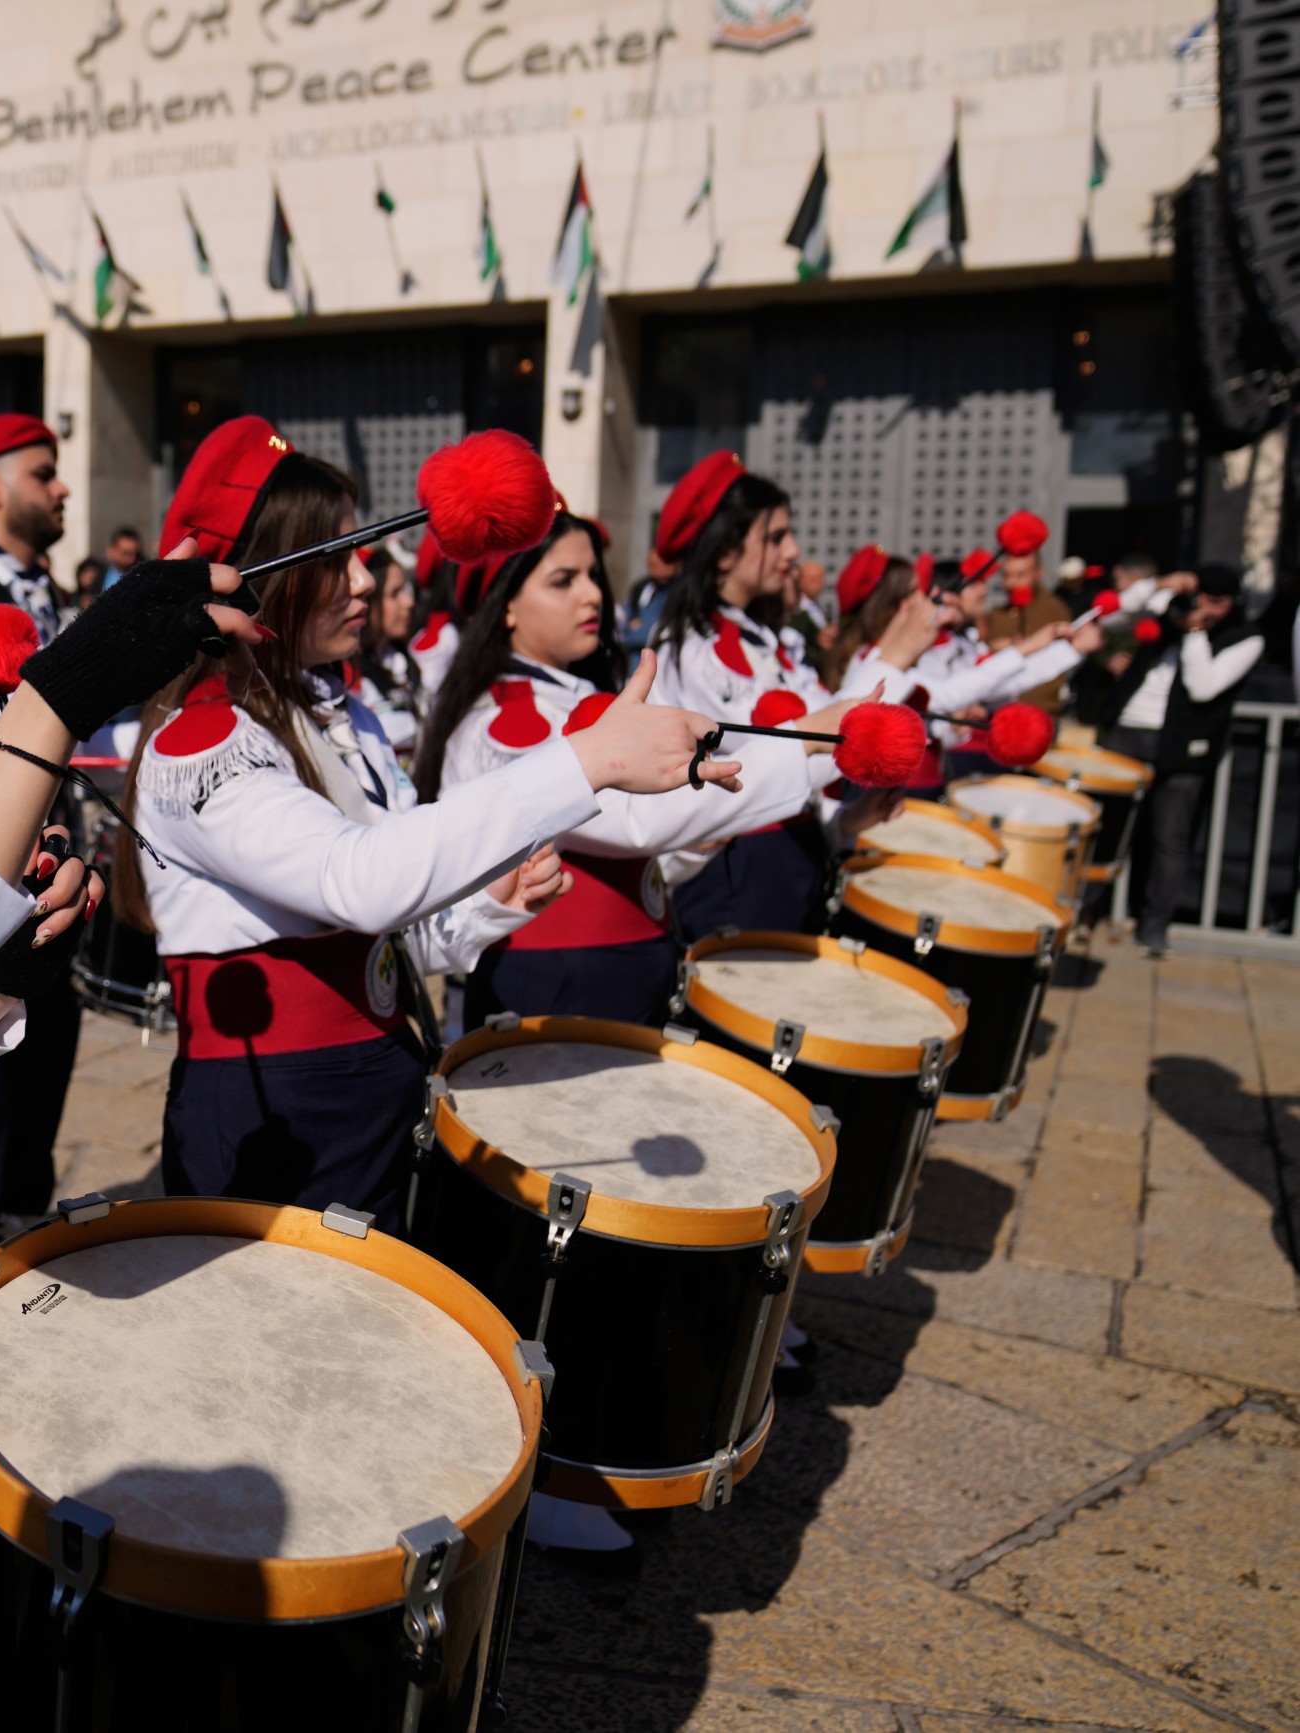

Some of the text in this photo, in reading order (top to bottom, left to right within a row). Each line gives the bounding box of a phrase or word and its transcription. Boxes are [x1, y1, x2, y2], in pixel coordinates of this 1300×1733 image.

[247, 57, 433, 117] Peace
[461, 23, 678, 86] Center
[21, 1286, 55, 1315] ANDANTE
